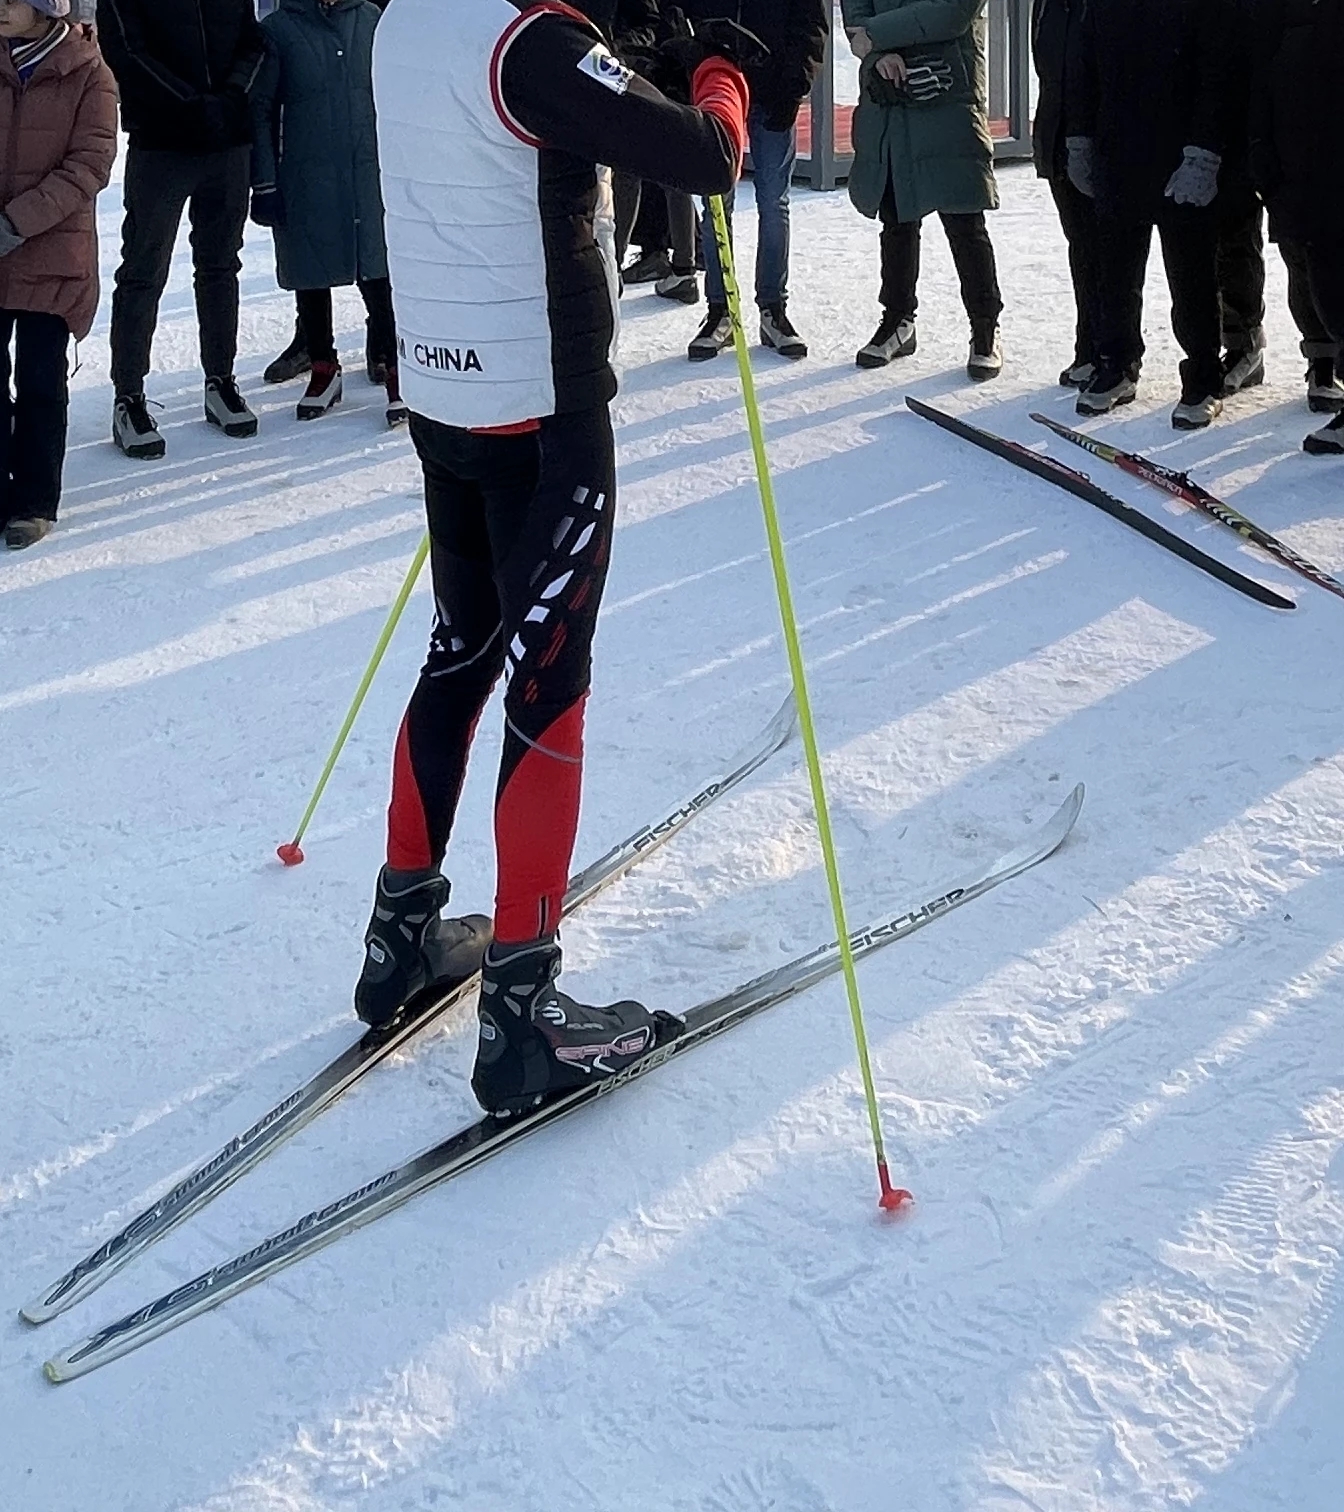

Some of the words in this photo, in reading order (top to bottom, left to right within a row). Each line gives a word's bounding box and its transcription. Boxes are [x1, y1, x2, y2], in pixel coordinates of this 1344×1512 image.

[414, 343, 483, 372] CHINA
[633, 783, 720, 852] FISCHER
[556, 1036, 645, 1060] SPINE
